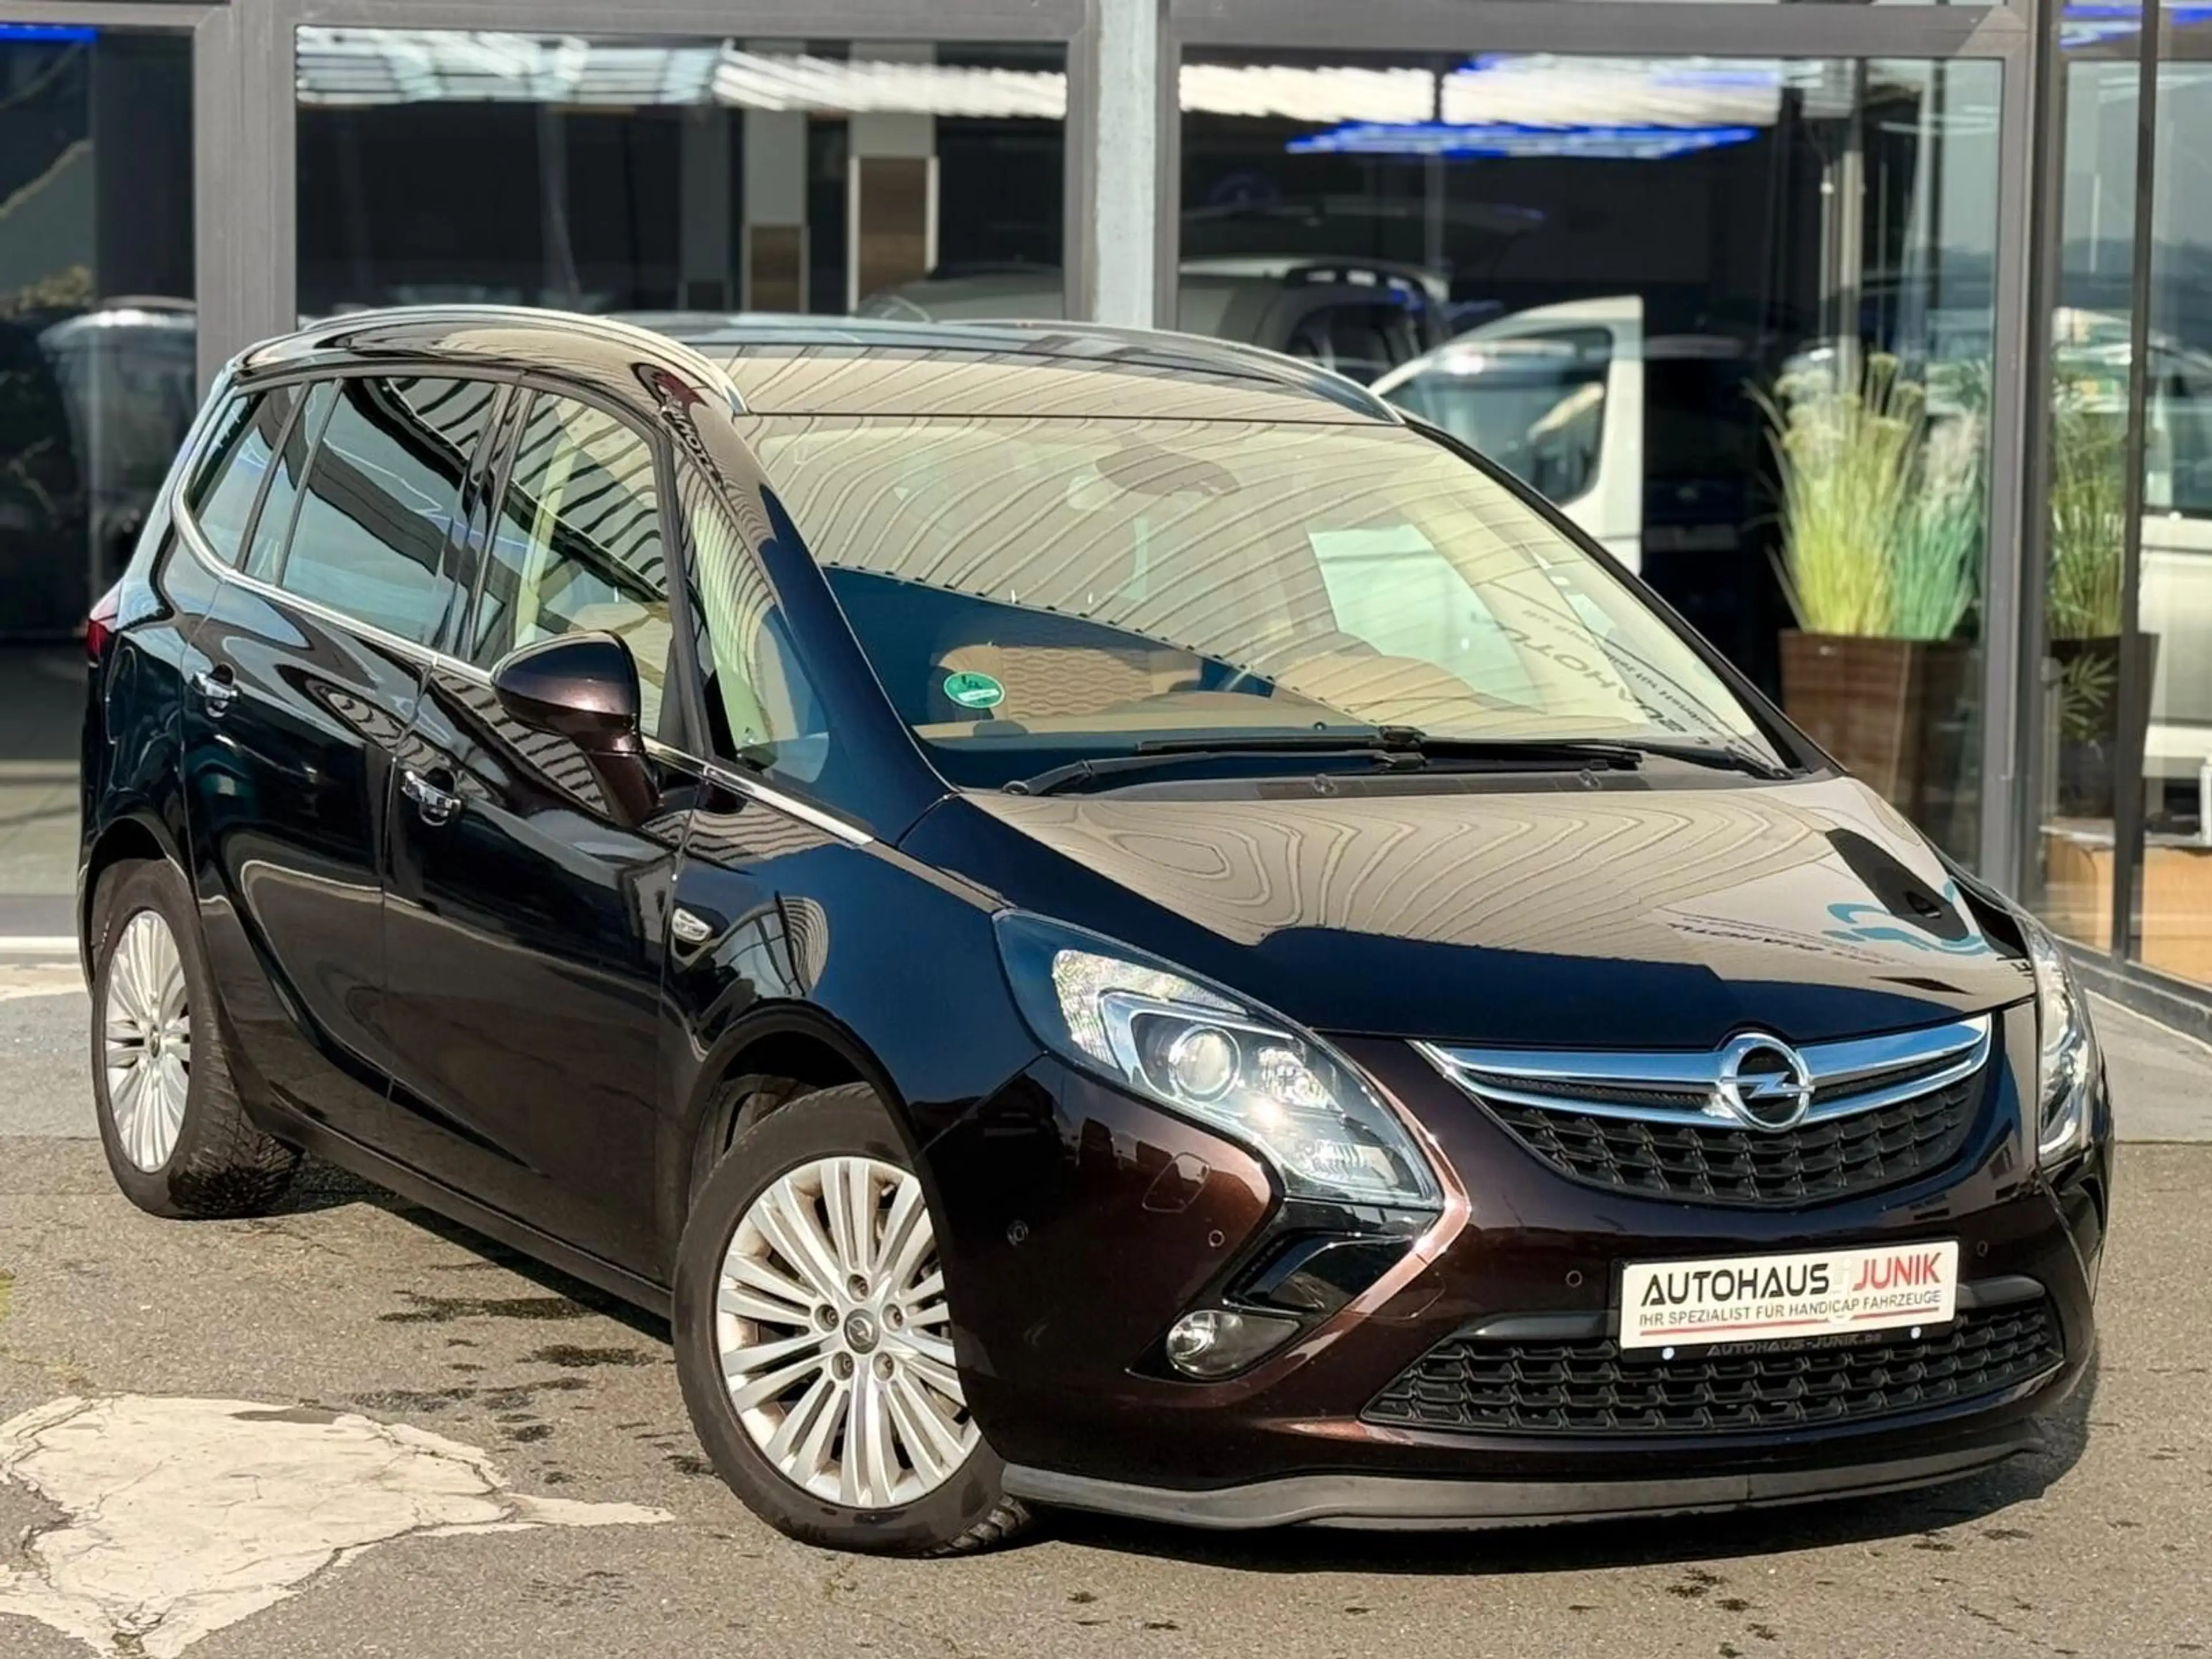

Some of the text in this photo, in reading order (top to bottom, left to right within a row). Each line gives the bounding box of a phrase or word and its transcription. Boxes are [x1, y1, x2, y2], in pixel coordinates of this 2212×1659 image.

[1641, 1252, 1942, 1306] AUTOHAUS JUNIK
[1639, 1290, 1942, 1327] IHR SPEZIALIST FÜR HANDICAP FAHRZEUGE
